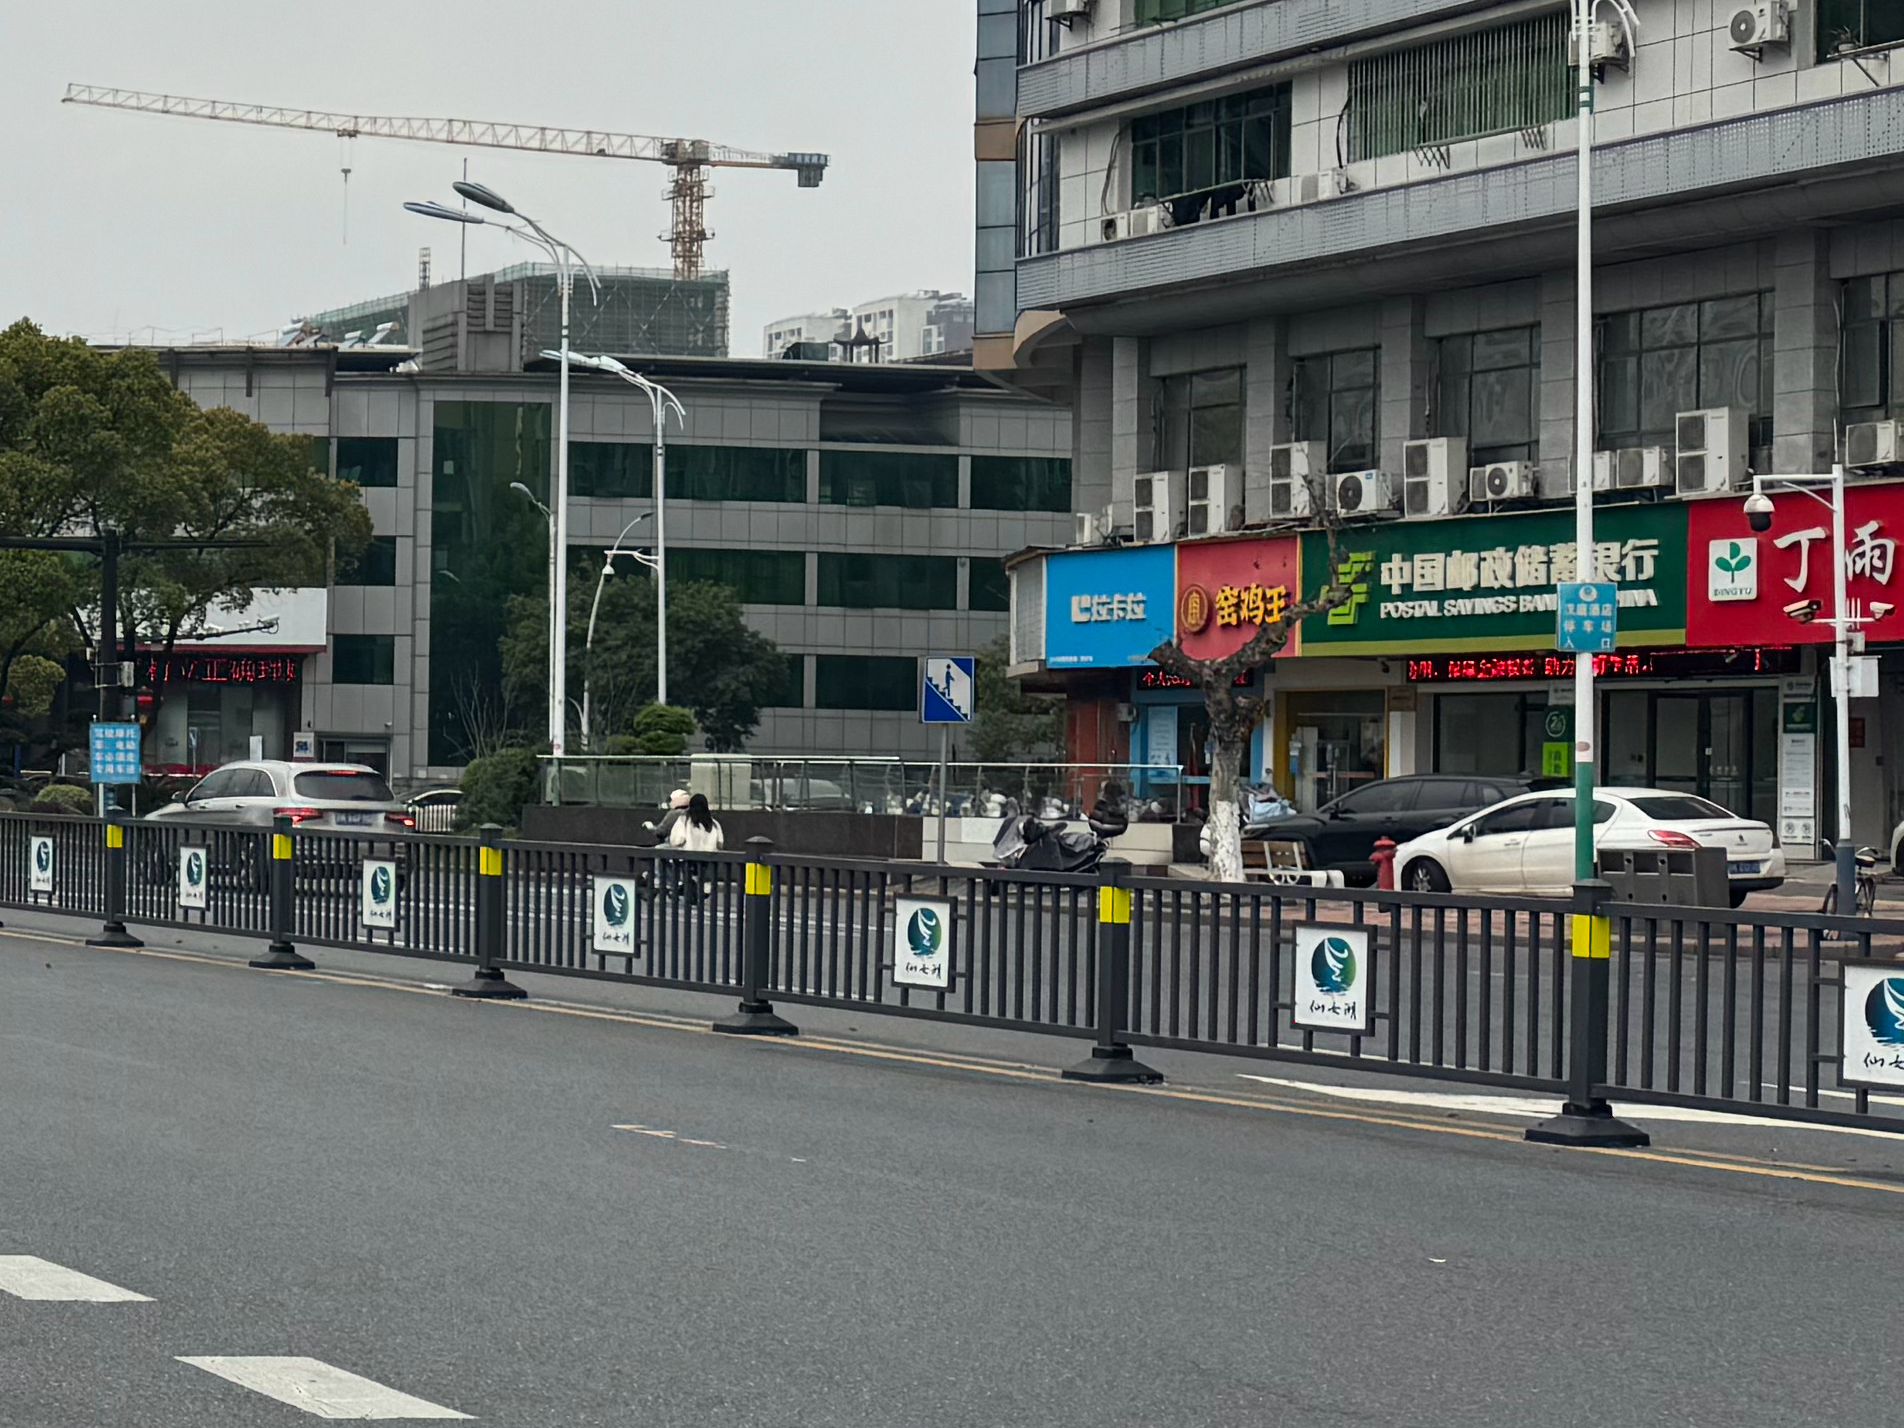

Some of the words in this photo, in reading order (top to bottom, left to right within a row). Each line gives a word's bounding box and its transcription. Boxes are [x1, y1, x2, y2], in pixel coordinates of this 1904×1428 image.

[1380, 538, 1659, 595] 中国邮政储蓄银行
[1215, 582, 1288, 626] 窑鸡王
[1380, 599, 1443, 619] POSTAL
[1443, 596, 1519, 617] SAVINGS
[1519, 593, 1558, 614] BAN
[1616, 588, 1658, 608] HINA
[1564, 636, 1611, 649] 入口
